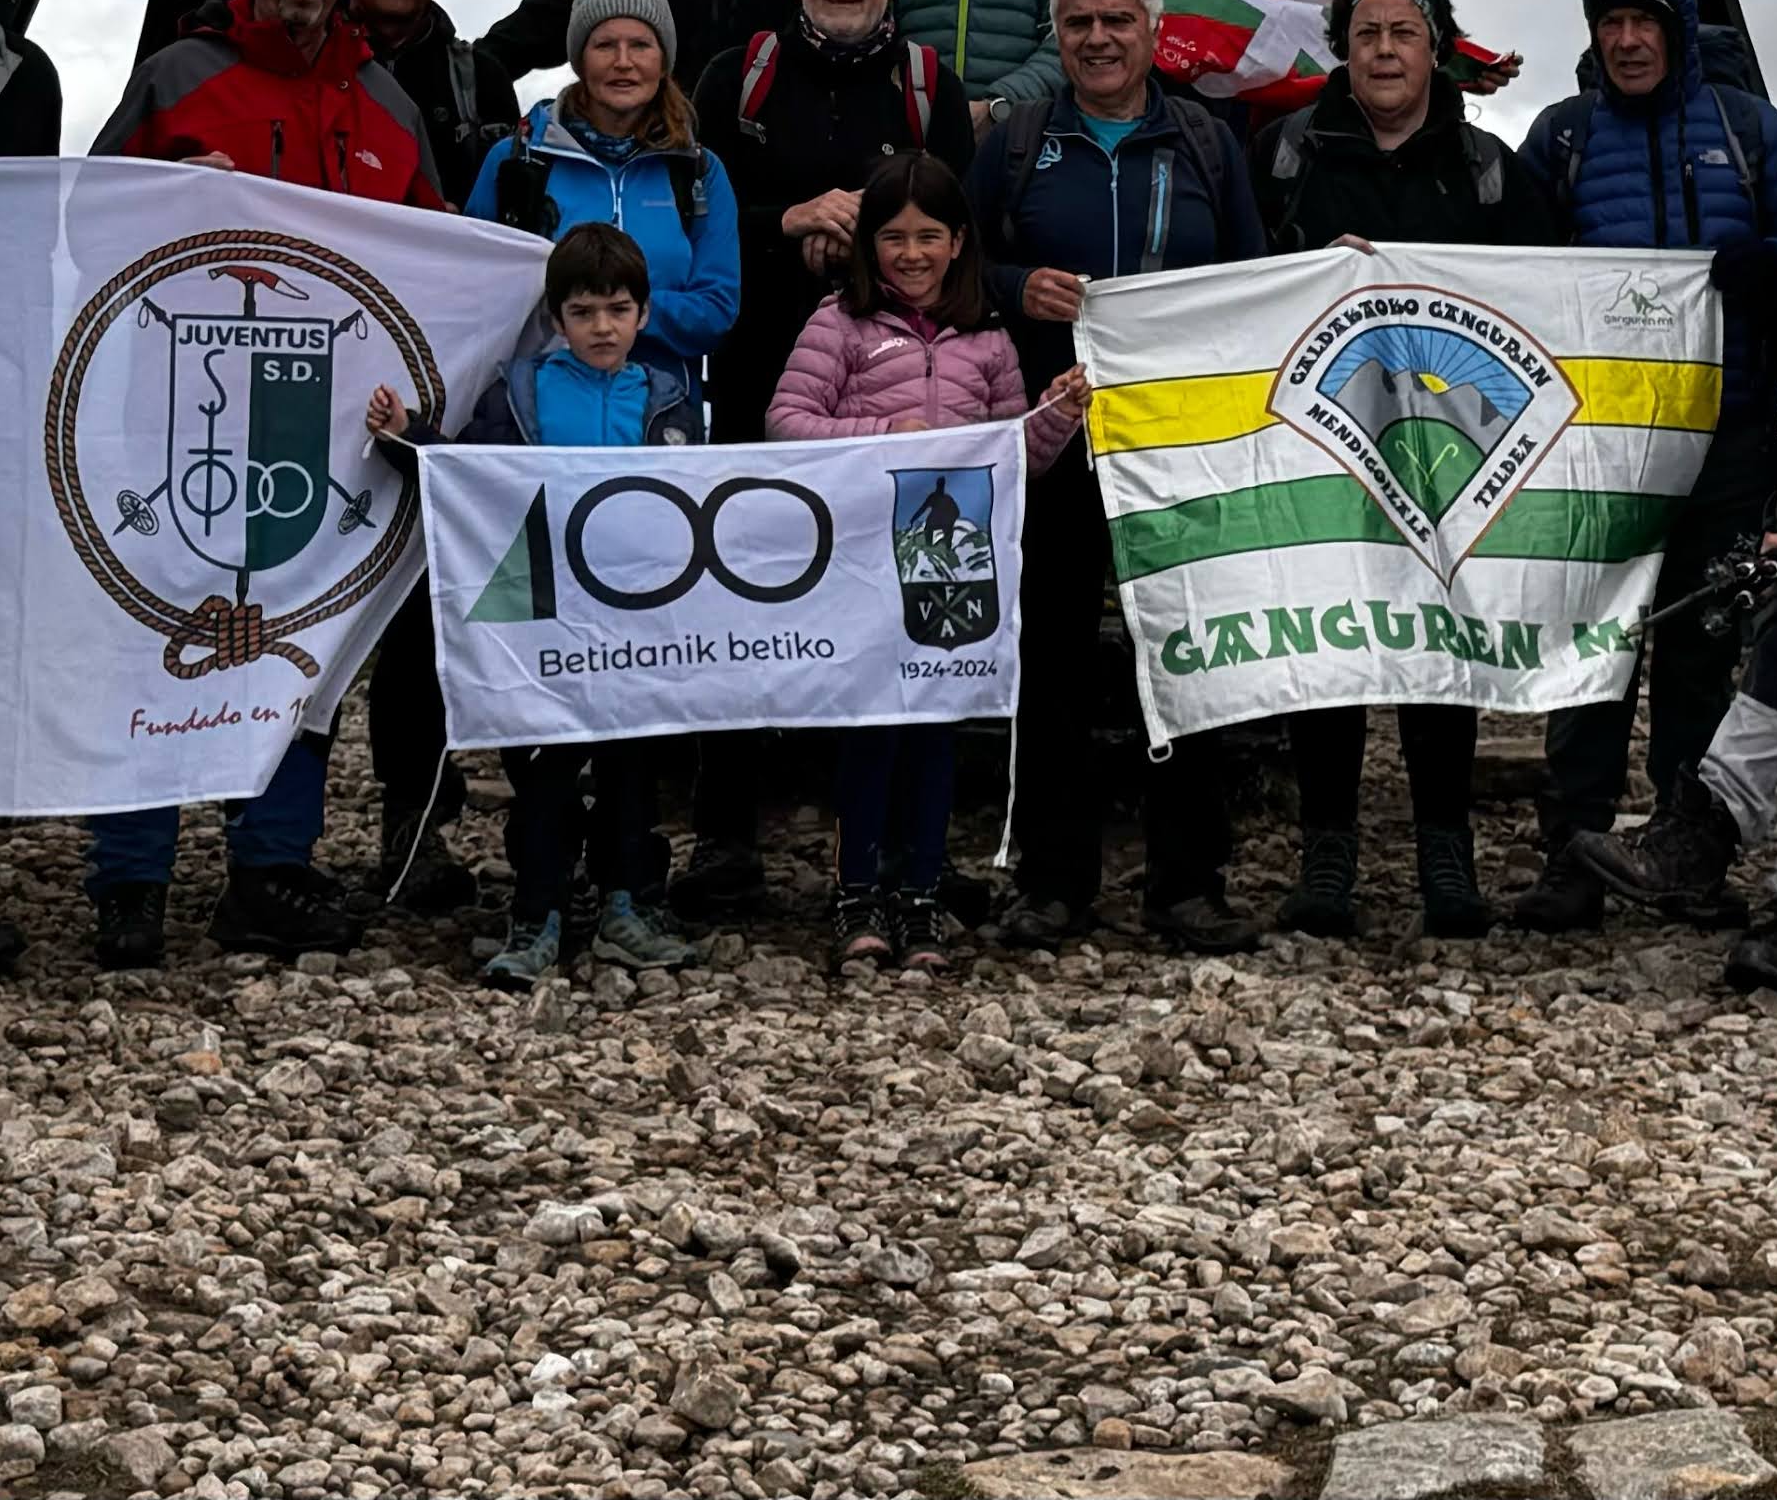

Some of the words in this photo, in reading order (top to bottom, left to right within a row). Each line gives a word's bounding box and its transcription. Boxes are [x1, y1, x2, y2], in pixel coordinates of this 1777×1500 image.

[178, 324, 325, 349] JUVENTUS
[1428, 300, 1553, 388] GANGUREN
[263, 360, 320, 382] S.D.
[1306, 403, 1431, 544] MENDIGOIZALE
[1473, 434, 1538, 509] TALDEA
[524, 476, 833, 620] 100
[918, 601, 933, 621] V
[966, 599, 983, 619] N
[940, 618, 956, 638] A
[1160, 599, 1544, 676] GANGUREN
[539, 633, 717, 677] Betidanik
[728, 631, 835, 661] betiko
[900, 659, 998, 679] 1924-2024
[130, 700, 242, 739] Fundado
[250, 706, 280, 723] en
